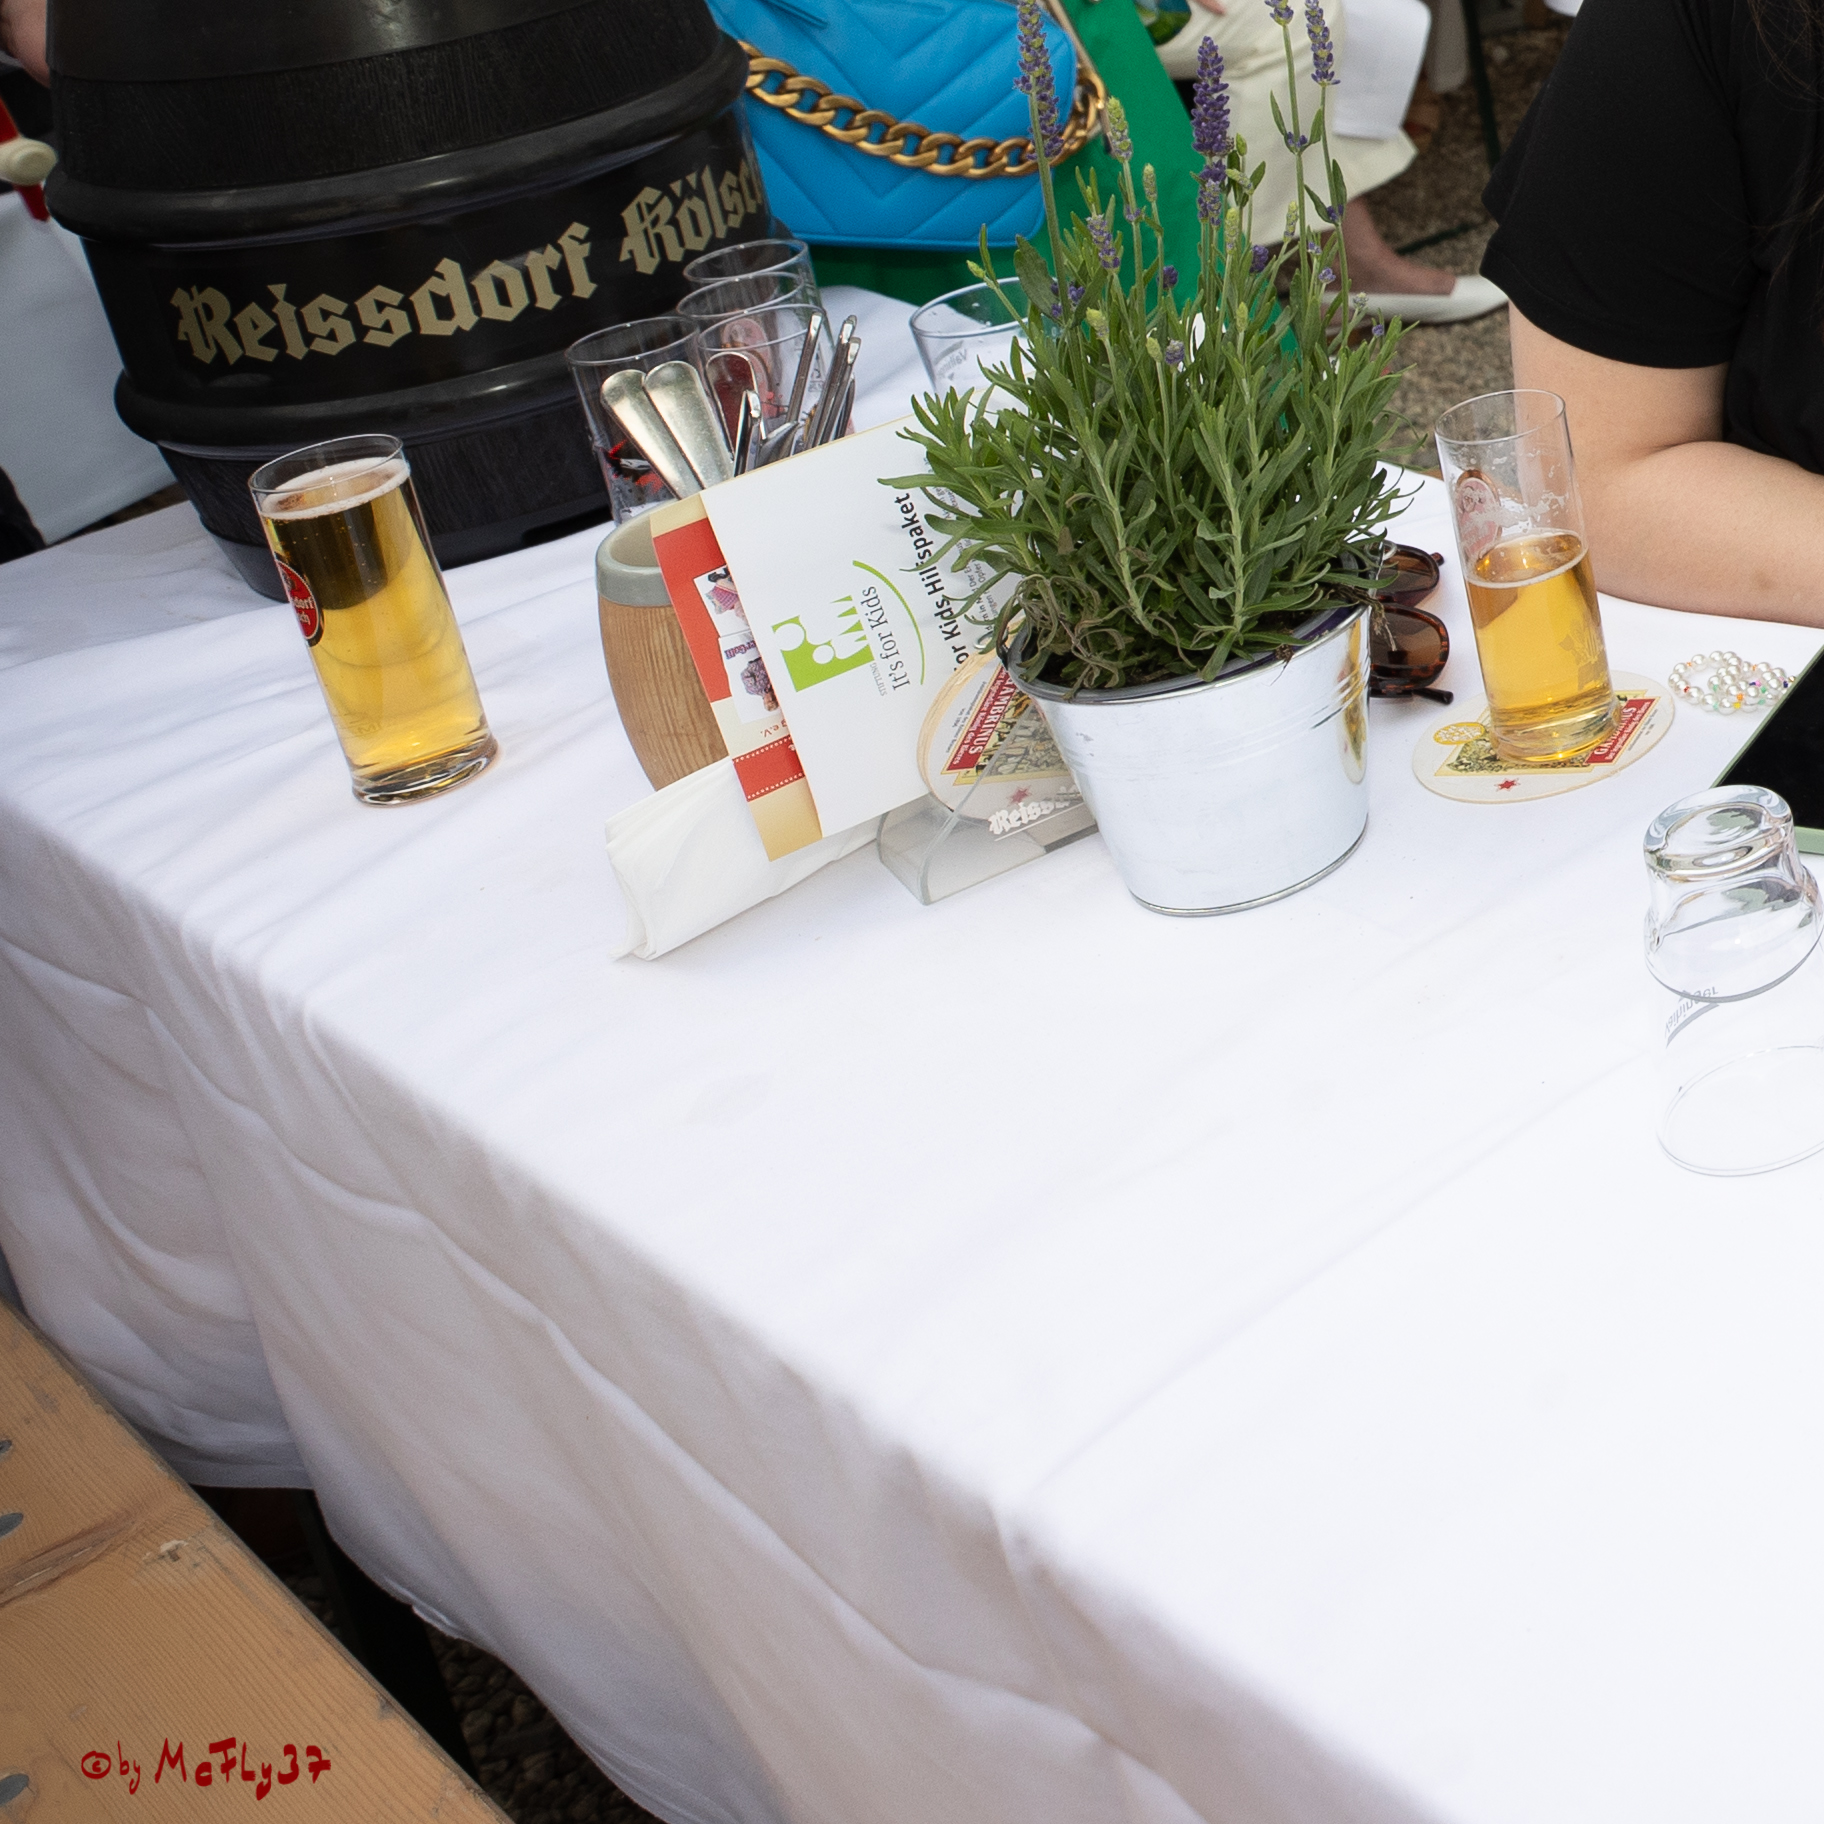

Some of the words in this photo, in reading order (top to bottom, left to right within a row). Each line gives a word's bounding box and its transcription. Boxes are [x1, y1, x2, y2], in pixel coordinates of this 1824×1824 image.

[170, 222, 598, 366] Reissdorf
[861, 585, 889, 631] Kids
[933, 594, 959, 643] Kids
[877, 632, 903, 661] for
[952, 645, 970, 672] or
[869, 662, 888, 697] STIFTUNG
